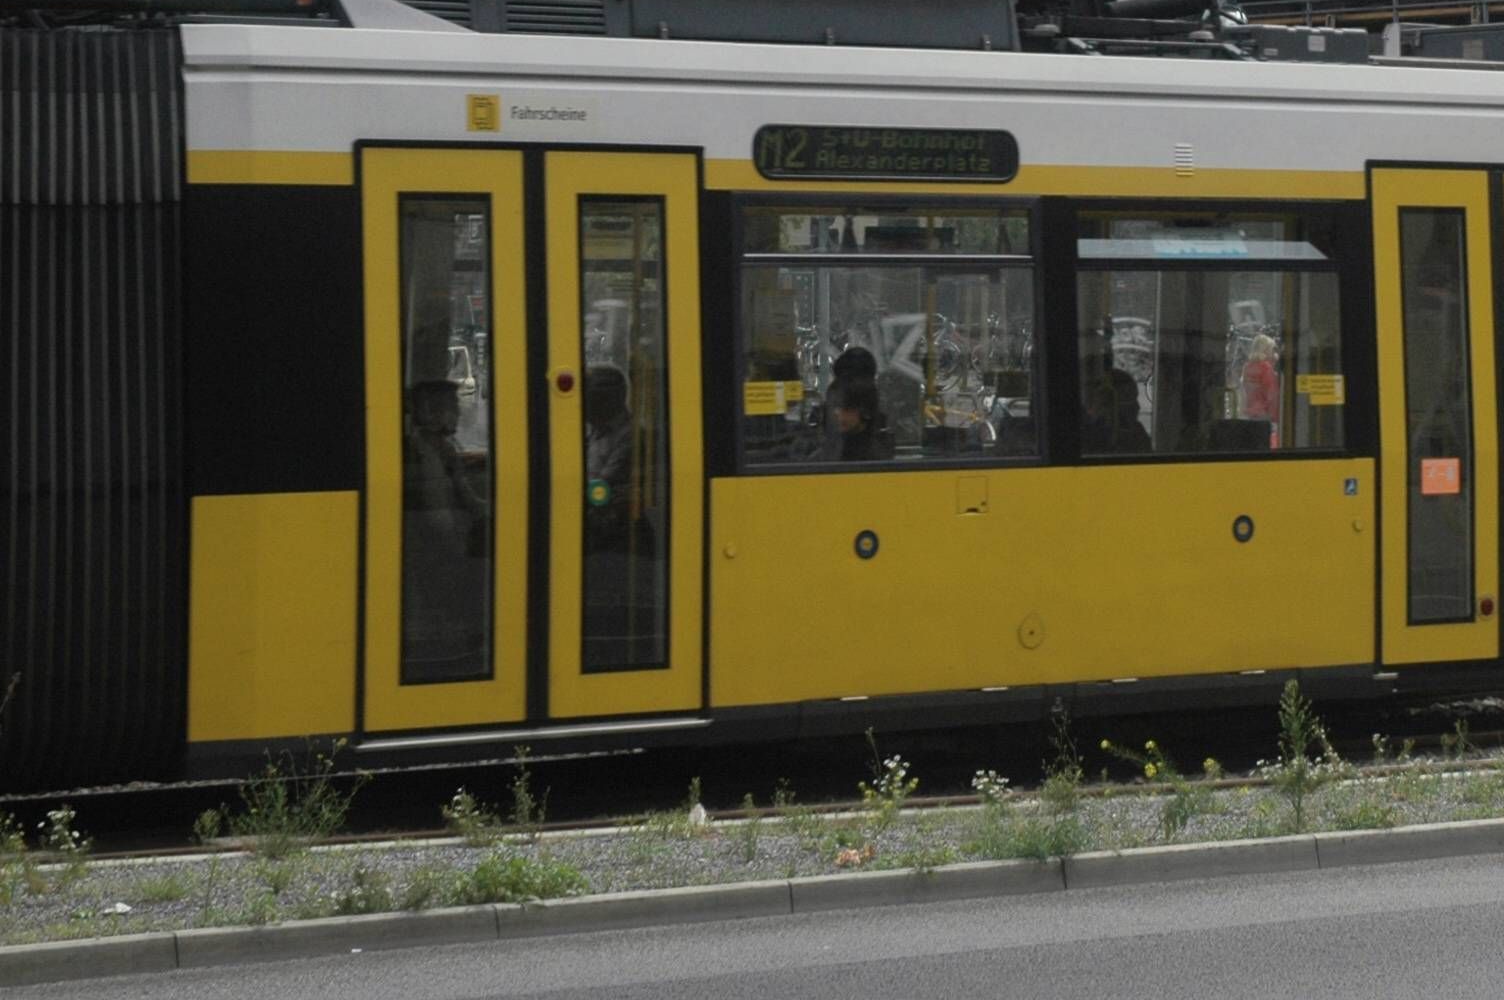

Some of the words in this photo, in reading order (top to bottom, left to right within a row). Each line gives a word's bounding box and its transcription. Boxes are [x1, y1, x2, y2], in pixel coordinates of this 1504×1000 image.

[511, 105, 587, 121] Fahrscheine
[760, 129, 808, 168] M2
[815, 151, 992, 172] Alexanderplatz
